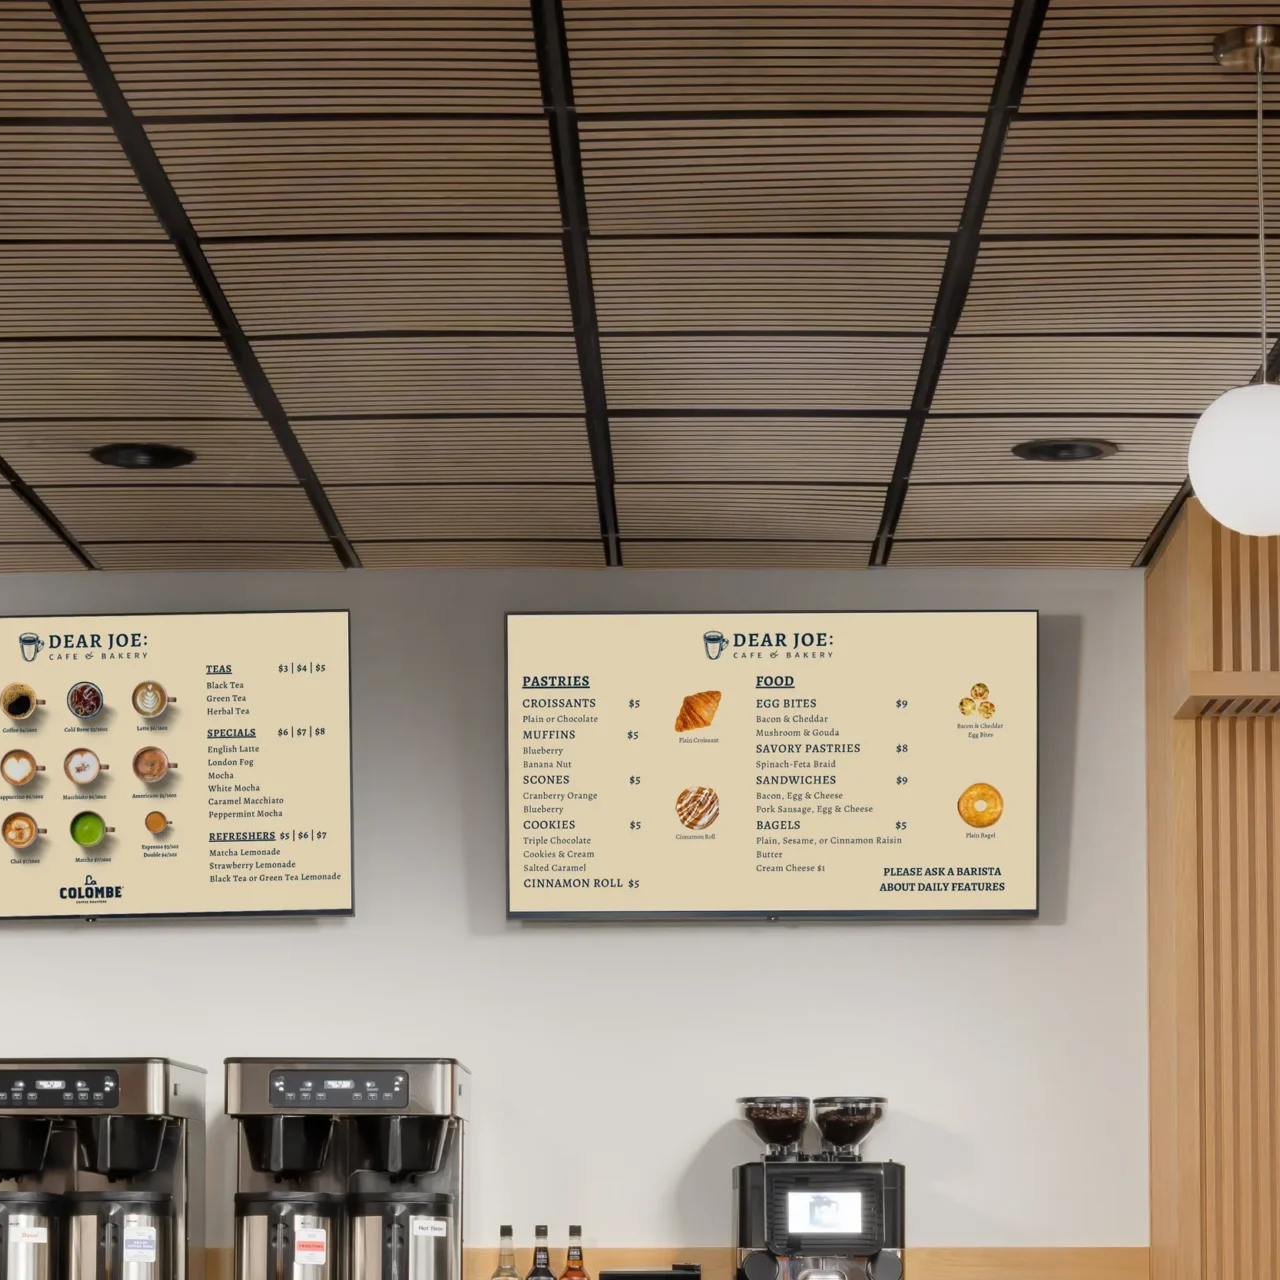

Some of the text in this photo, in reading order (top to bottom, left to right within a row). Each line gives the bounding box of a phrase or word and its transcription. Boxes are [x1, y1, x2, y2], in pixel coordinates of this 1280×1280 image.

[49, 633, 147, 650] DEAR JOE:
[733, 632, 833, 649] DEAR JOE:
[48, 652, 148, 661] CAFE & BAKERY
[206, 663, 326, 674] TEAS $3 $4 $5
[206, 681, 244, 690] Black Tea
[523, 676, 590, 687] PASTRIES
[756, 676, 794, 687] FOOD
[522, 698, 640, 709] CROISSANTS $5
[756, 699, 908, 709] EGG BITES $9
[207, 727, 325, 738] SPECIALS $6 $7 $8
[523, 730, 639, 740] MUFFINS $5
[208, 744, 260, 755] English Latte
[523, 746, 564, 757] Blueberry
[756, 743, 908, 754] SAVORY PASTRIES $8
[208, 758, 254, 768] London Fog
[556, 760, 572, 768] Nut
[756, 760, 836, 770] Spinach-Feta Braid
[523, 775, 641, 785] SCONES $5
[756, 775, 908, 785] SANDWICHES $9
[208, 796, 284, 806] Caramel Macchiato
[523, 791, 598, 802] Cranberry Orange
[209, 809, 283, 820] Peppermint Mocha
[756, 805, 873, 815] Pork Sausage, Egg & Cheese
[523, 820, 641, 830] COOKIES $5
[756, 820, 907, 830] BAGELS $5
[209, 831, 327, 841] REFRESHERS $5 $6 $7
[756, 836, 781, 845] Plain,
[783, 837, 817, 845] Sesame,
[830, 836, 874, 844] Cinnamon
[876, 836, 902, 844] Raisin
[523, 836, 591, 847] Triple Chocolate
[209, 847, 281, 857] Matcha Lemonade
[209, 860, 296, 871] Strawberry Lemonade
[524, 863, 586, 872] Salted Caramel
[884, 867, 1002, 876] PLEASE ASK A BARISTA
[84, 874, 97, 886] La
[523, 878, 640, 889] CINNAMON ROLL $5
[879, 882, 1005, 892] ABOUT DAILY FEATURES
[59, 886, 122, 899] COLOMBE
